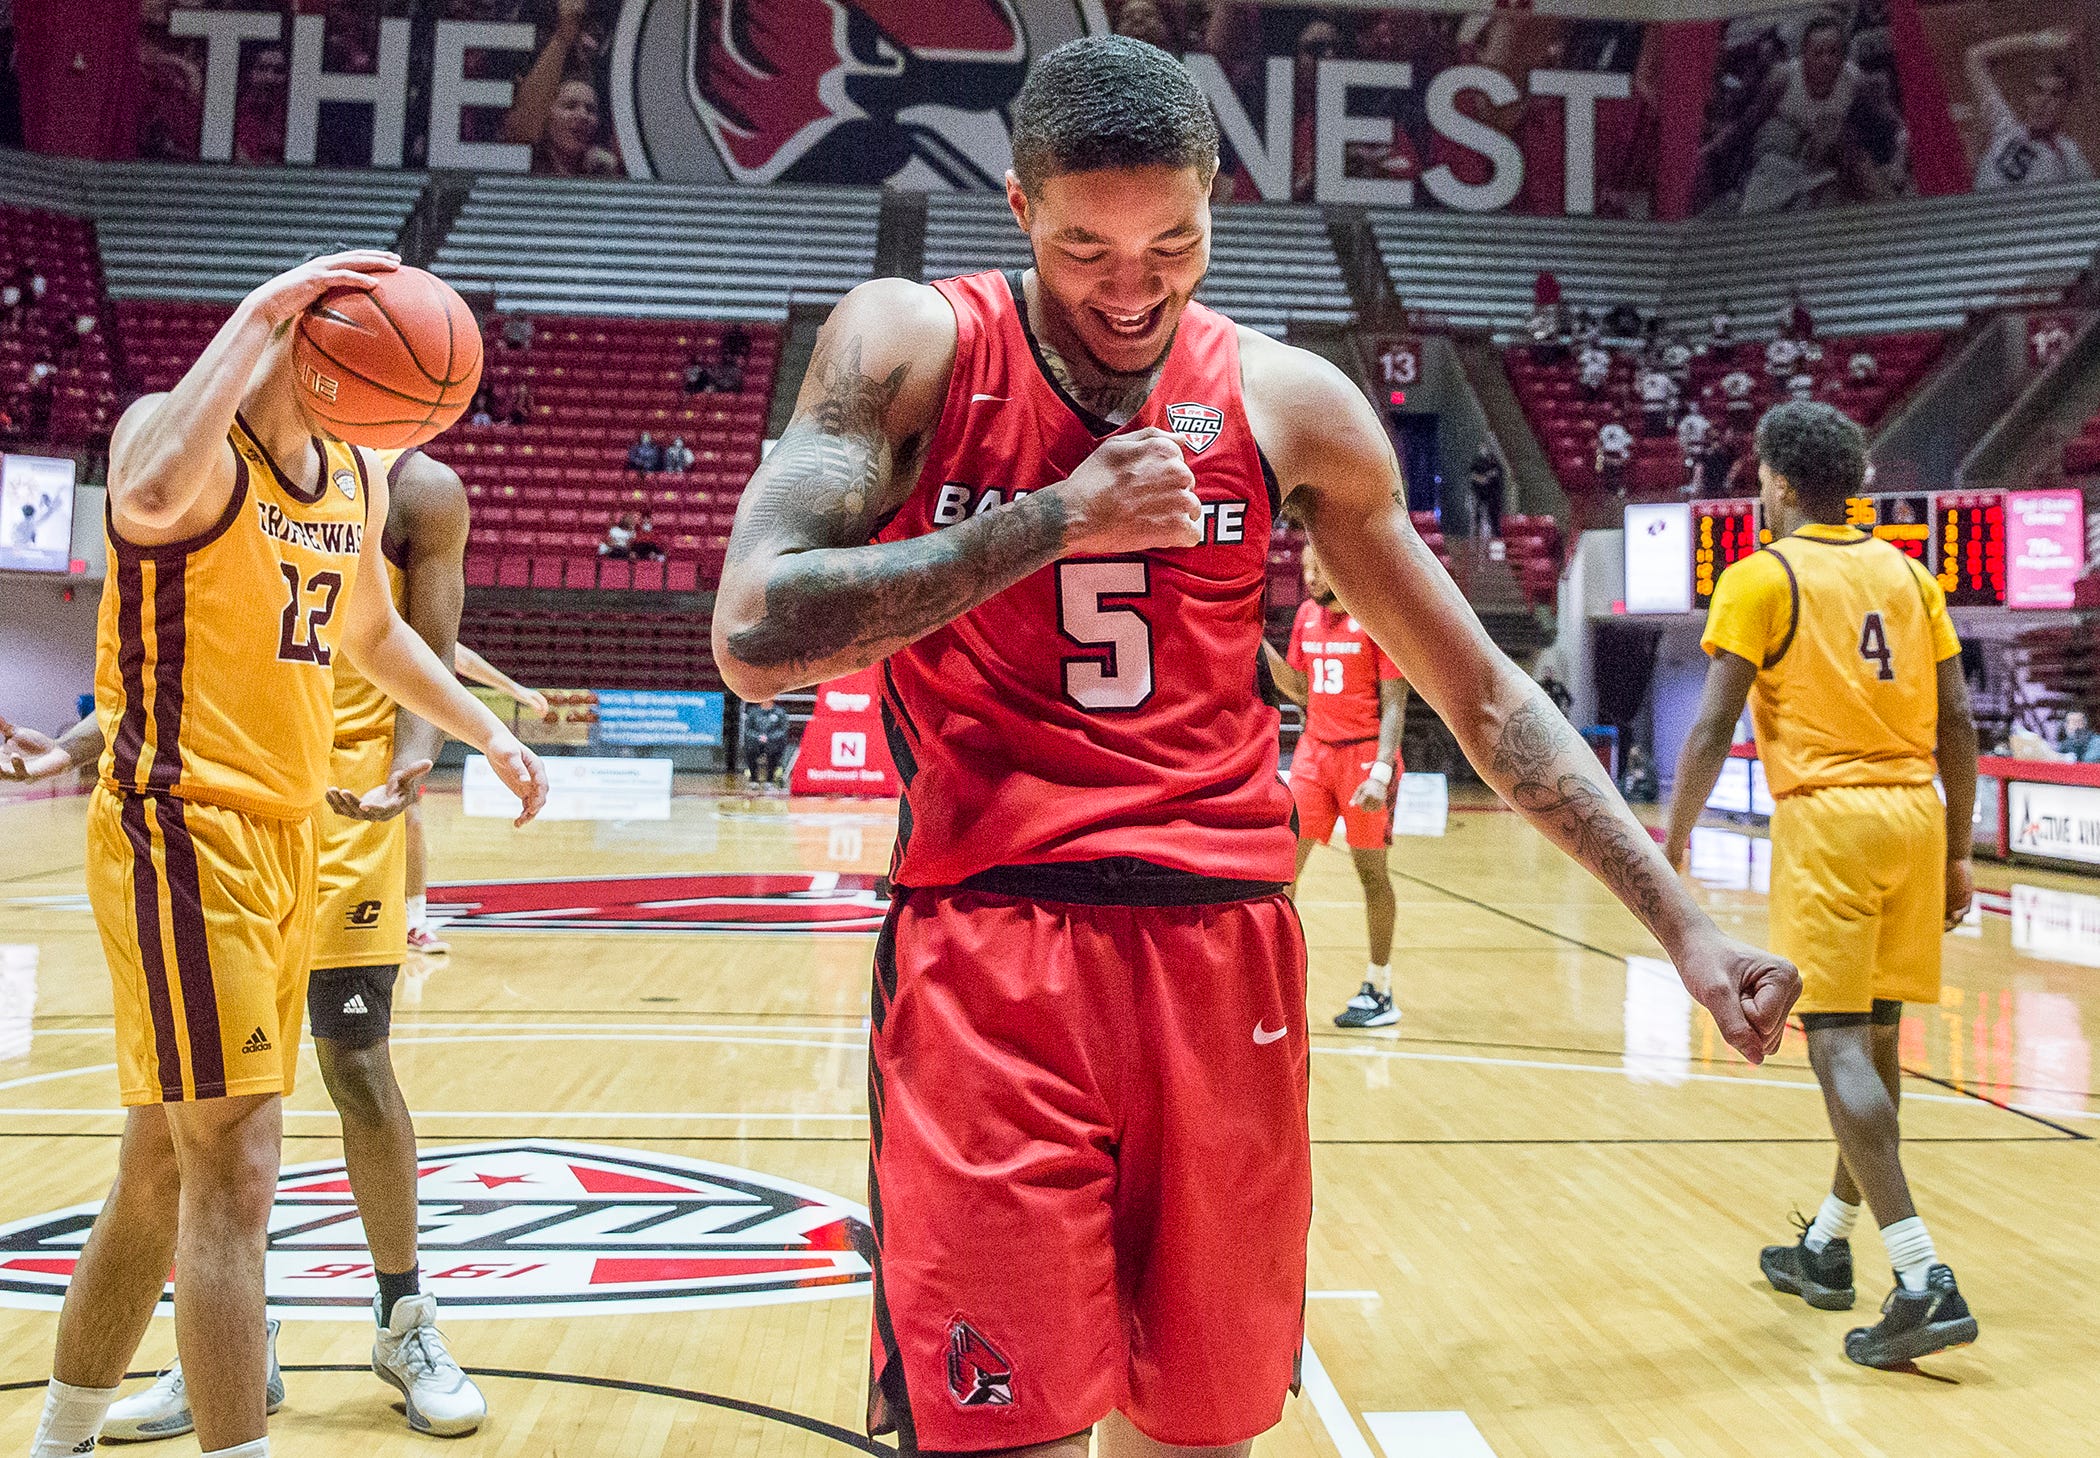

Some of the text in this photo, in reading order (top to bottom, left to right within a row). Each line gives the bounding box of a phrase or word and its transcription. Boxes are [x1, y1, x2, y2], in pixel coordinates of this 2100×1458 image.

[169, 10, 1632, 216] THE NEST
[1381, 351, 1416, 382] 13
[1172, 418, 1220, 432] MAC
[1055, 557, 1155, 712] 5
[1860, 613, 1893, 679] 4
[1312, 658, 1344, 695] 13
[841, 741, 857, 757] N
[241, 1041, 272, 1055] adidas
